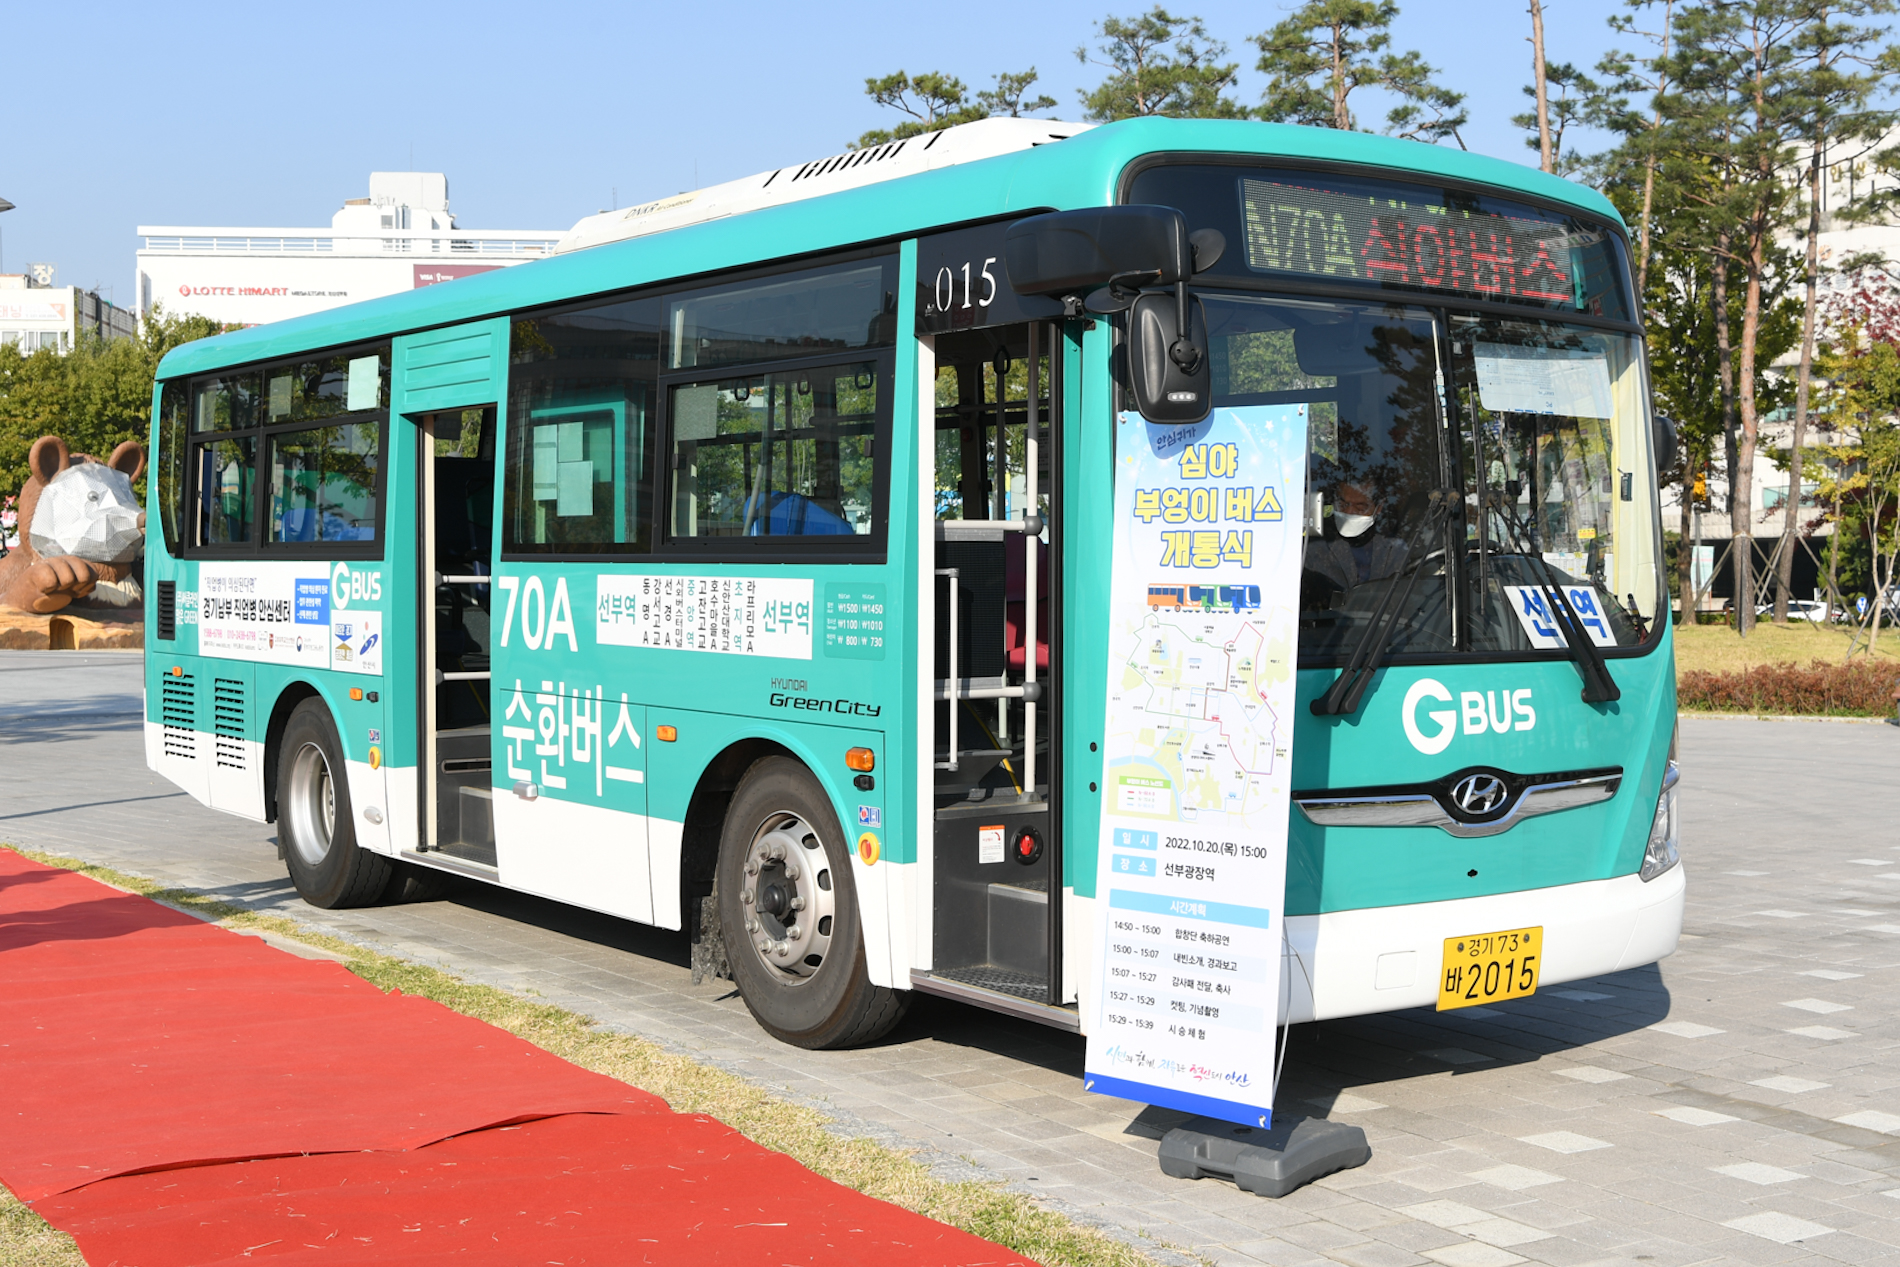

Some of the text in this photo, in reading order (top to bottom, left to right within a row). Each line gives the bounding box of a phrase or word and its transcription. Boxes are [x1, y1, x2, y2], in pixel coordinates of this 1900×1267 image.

[1246, 200, 1358, 276] N70A
[33, 264, 55, 286] 장
[193, 287, 235, 296] LOTTE
[238, 287, 288, 296] HIMART
[935, 257, 997, 312] 015
[1156, 427, 1197, 450] 안심귀가
[1178, 442, 1239, 480] 심야
[1133, 486, 1284, 524] 부엉이 버스
[1159, 530, 1253, 569] 개통식
[203, 597, 232, 620] 경기남부
[234, 599, 257, 622] 직업병
[258, 599, 291, 623] 안심센터
[498, 575, 579, 652] 70A
[598, 593, 637, 626] 선부역
[653, 578, 662, 646] 강서고교
[675, 578, 684, 648] 시외버스터미널
[686, 579, 695, 648] 중앙역
[698, 580, 707, 649] 고잔고교
[721, 579, 731, 651] 신안산대학교
[733, 580, 743, 652] 초지역
[746, 580, 756, 653] 라프리모A
[762, 599, 810, 636] 선부역
[771, 678, 808, 692] HYUNDAI
[502, 678, 644, 797] 순환버스
[1165, 837, 1267, 859] 2022.10.20.(목) 15:00
[1164, 862, 1215, 882] 선부광장역
[1170, 900, 1207, 917] 시간계획
[1114, 920, 1133, 932] 14:50
[1141, 924, 1161, 936] 15:00
[1175, 928, 1198, 942] 합창단
[1199, 931, 1230, 947] 축하공연
[1468, 934, 1520, 957] 경기 73
[1113, 944, 1132, 955] 15:00
[1140, 948, 1159, 959] 15:07
[1173, 952, 1205, 967] 내빈소개,
[1207, 957, 1238, 972] 경과보고
[1111, 967, 1130, 978] 15:07
[1138, 971, 1157, 983] 15:27
[1172, 976, 1194, 990] 감사패
[1196, 979, 1214, 994] 전달,
[1215, 983, 1231, 996] 축사
[1464, 955, 1536, 1001] 2015
[1108, 1014, 1127, 1025] 15:29
[1135, 1018, 1154, 1030] 15:39
[1110, 990, 1128, 1001] 15:27
[1136, 995, 1155, 1006] 15:29
[1189, 1003, 1220, 1019] 기념촬영
[1225, 1070, 1252, 1088] 안산
